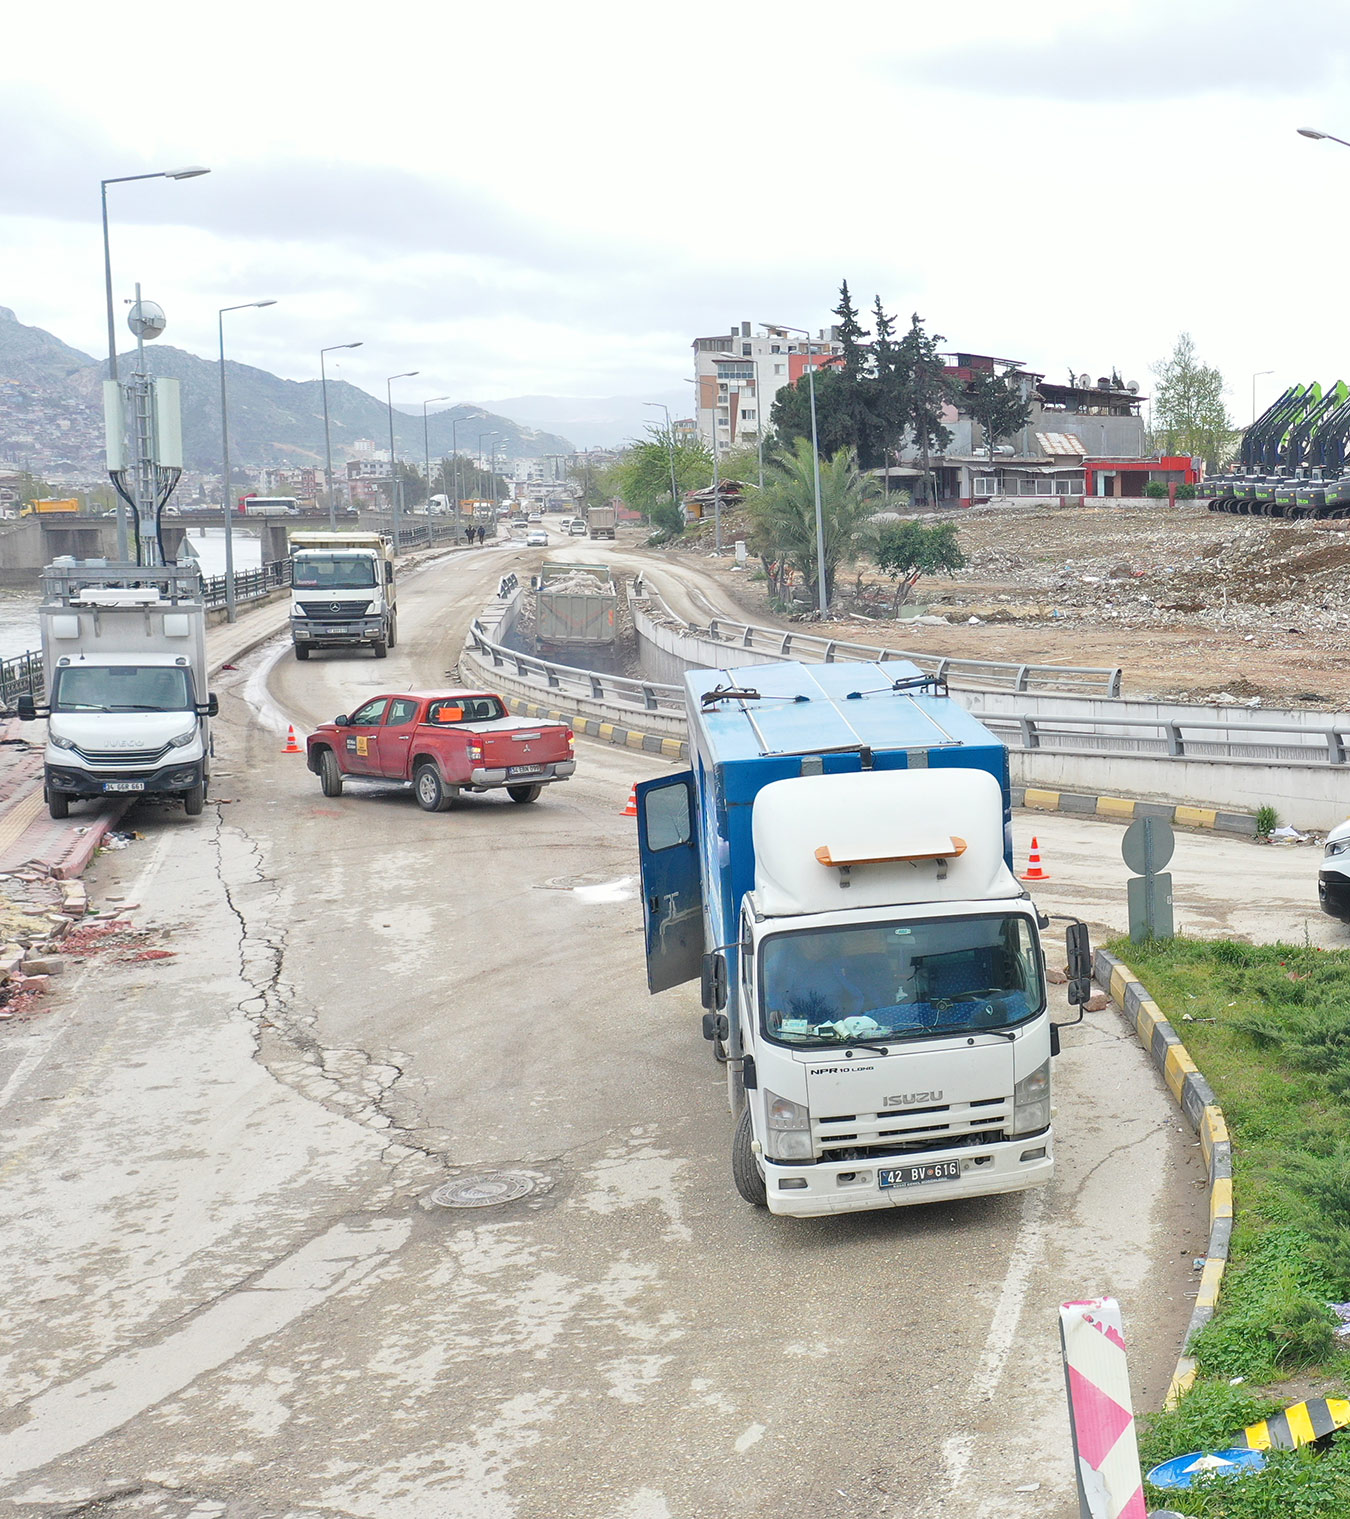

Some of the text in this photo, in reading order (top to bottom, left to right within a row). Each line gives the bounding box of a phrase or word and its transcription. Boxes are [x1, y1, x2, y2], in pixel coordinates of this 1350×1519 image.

[104, 740, 144, 748] IVECO
[811, 1067, 838, 1075] NPR
[883, 1090, 944, 1107] ISUZU
[888, 1163, 956, 1183] 42 BV 616
